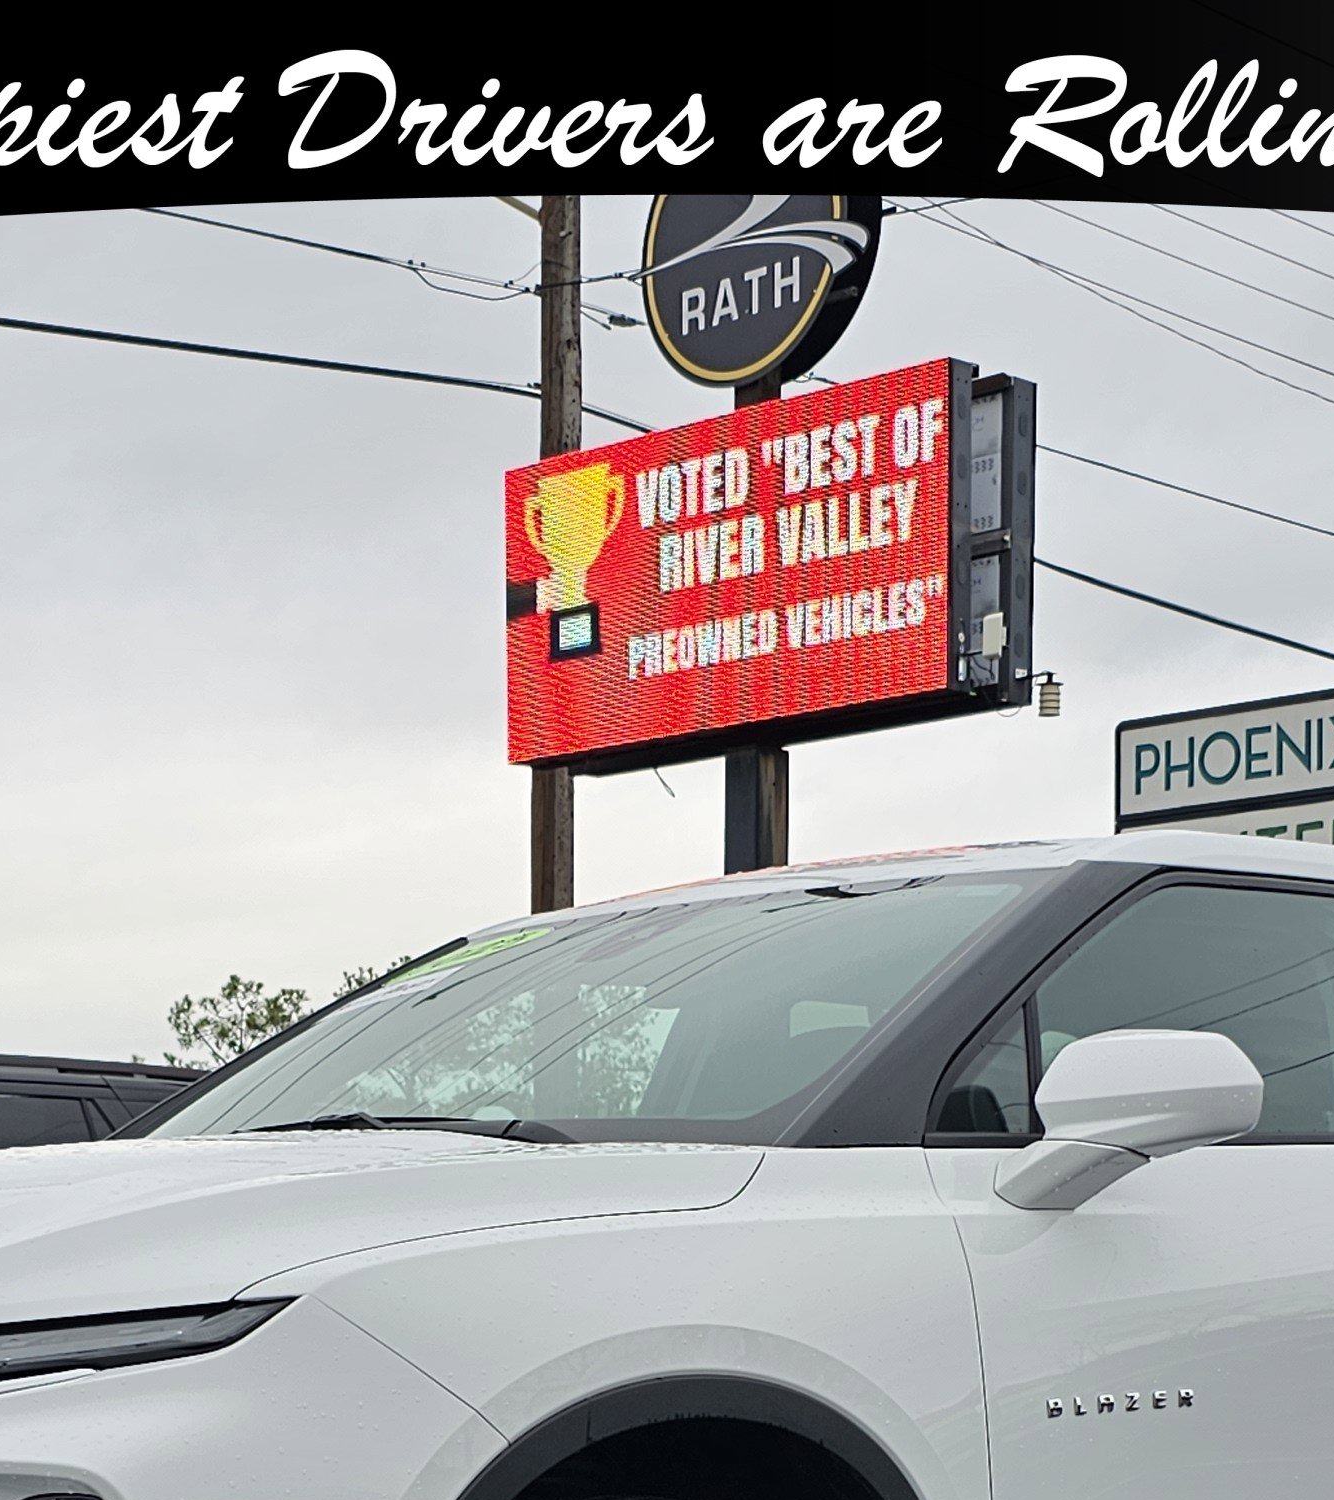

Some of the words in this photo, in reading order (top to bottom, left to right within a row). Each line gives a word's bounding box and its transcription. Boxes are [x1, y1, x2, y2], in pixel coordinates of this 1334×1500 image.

[680, 255, 801, 336] RATH
[635, 447, 750, 529] VOTED
[761, 413, 880, 496] "BEST
[892, 397, 945, 470] OF
[657, 513, 766, 595] RIVER
[776, 477, 920, 568] VALLEY
[626, 608, 778, 681] PREOWNED
[785, 573, 945, 650] VEHICLES"
[1046, 1388, 1194, 1419] BLAZER
